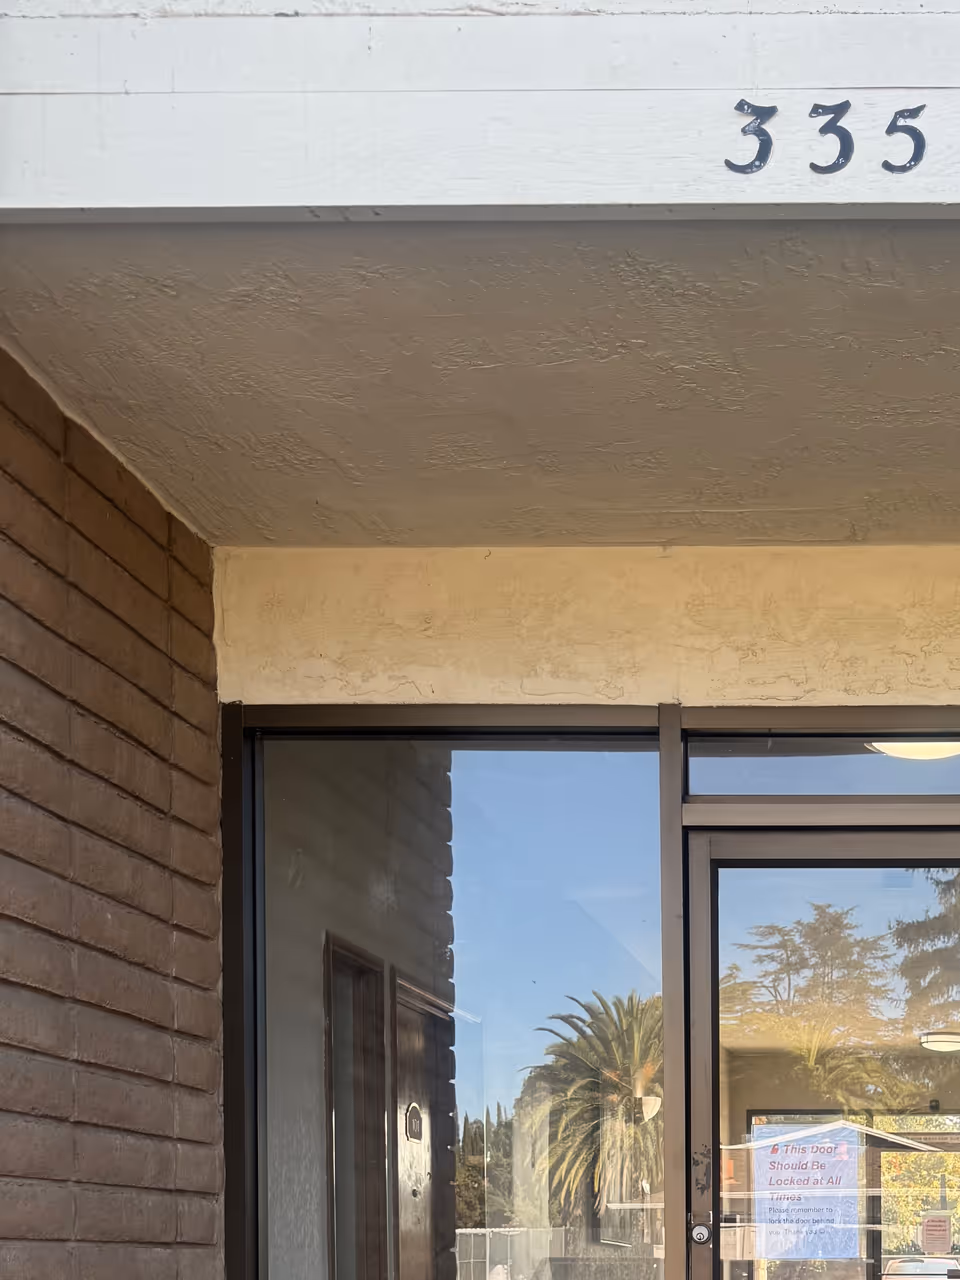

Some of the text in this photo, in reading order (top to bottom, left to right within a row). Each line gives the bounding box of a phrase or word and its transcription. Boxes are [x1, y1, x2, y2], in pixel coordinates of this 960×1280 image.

[784, 1144, 839, 1155] This Door
[769, 1160, 827, 1171] Should Be
[768, 1176, 842, 1186] Locked at All
[769, 1192, 802, 1202] Times
[768, 1217, 835, 1225] lock the door behind
